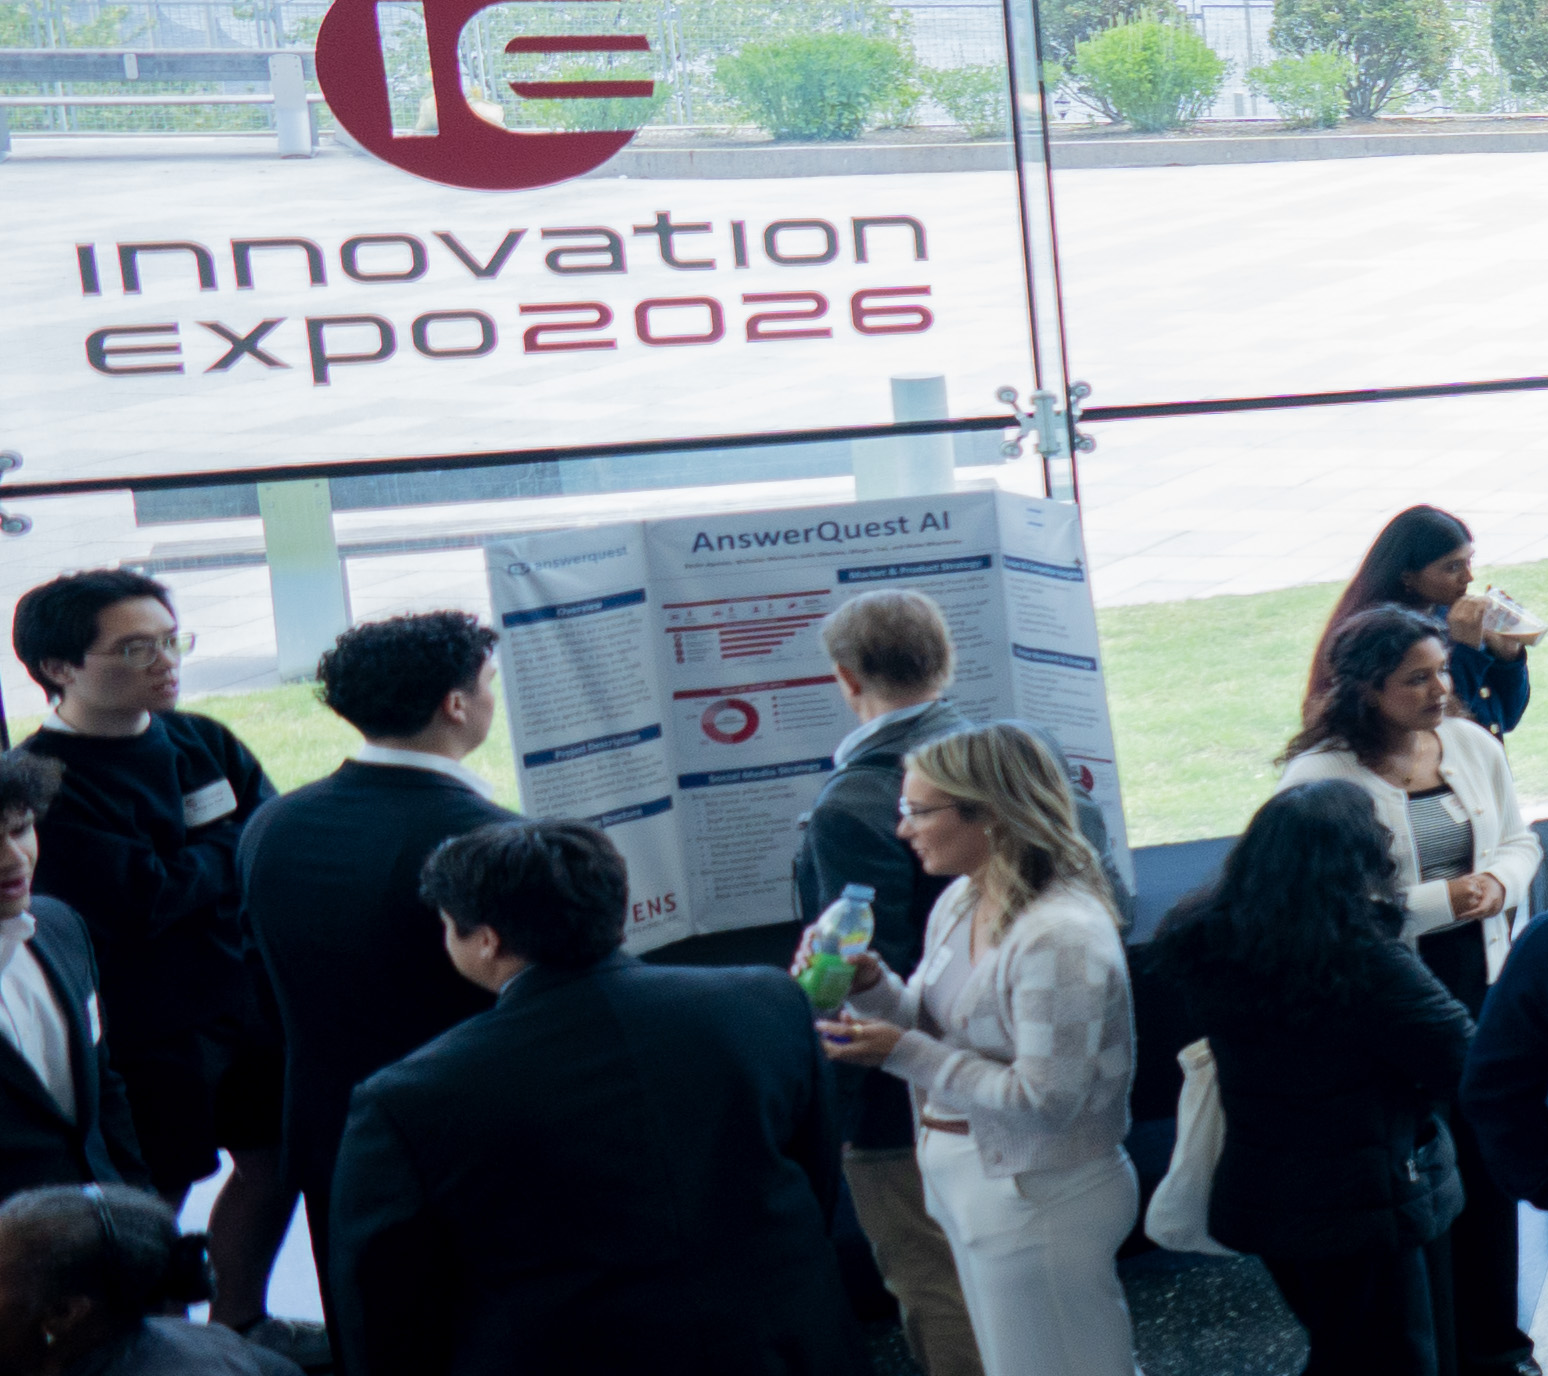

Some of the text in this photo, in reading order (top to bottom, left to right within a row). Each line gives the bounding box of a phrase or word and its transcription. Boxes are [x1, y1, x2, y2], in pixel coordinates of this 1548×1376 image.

[77, 210, 928, 294] innovation
[85, 285, 933, 385] expo2026
[535, 546, 628, 571] answerquest
[692, 515, 910, 554] AnswerQuest
[919, 510, 951, 532] AI
